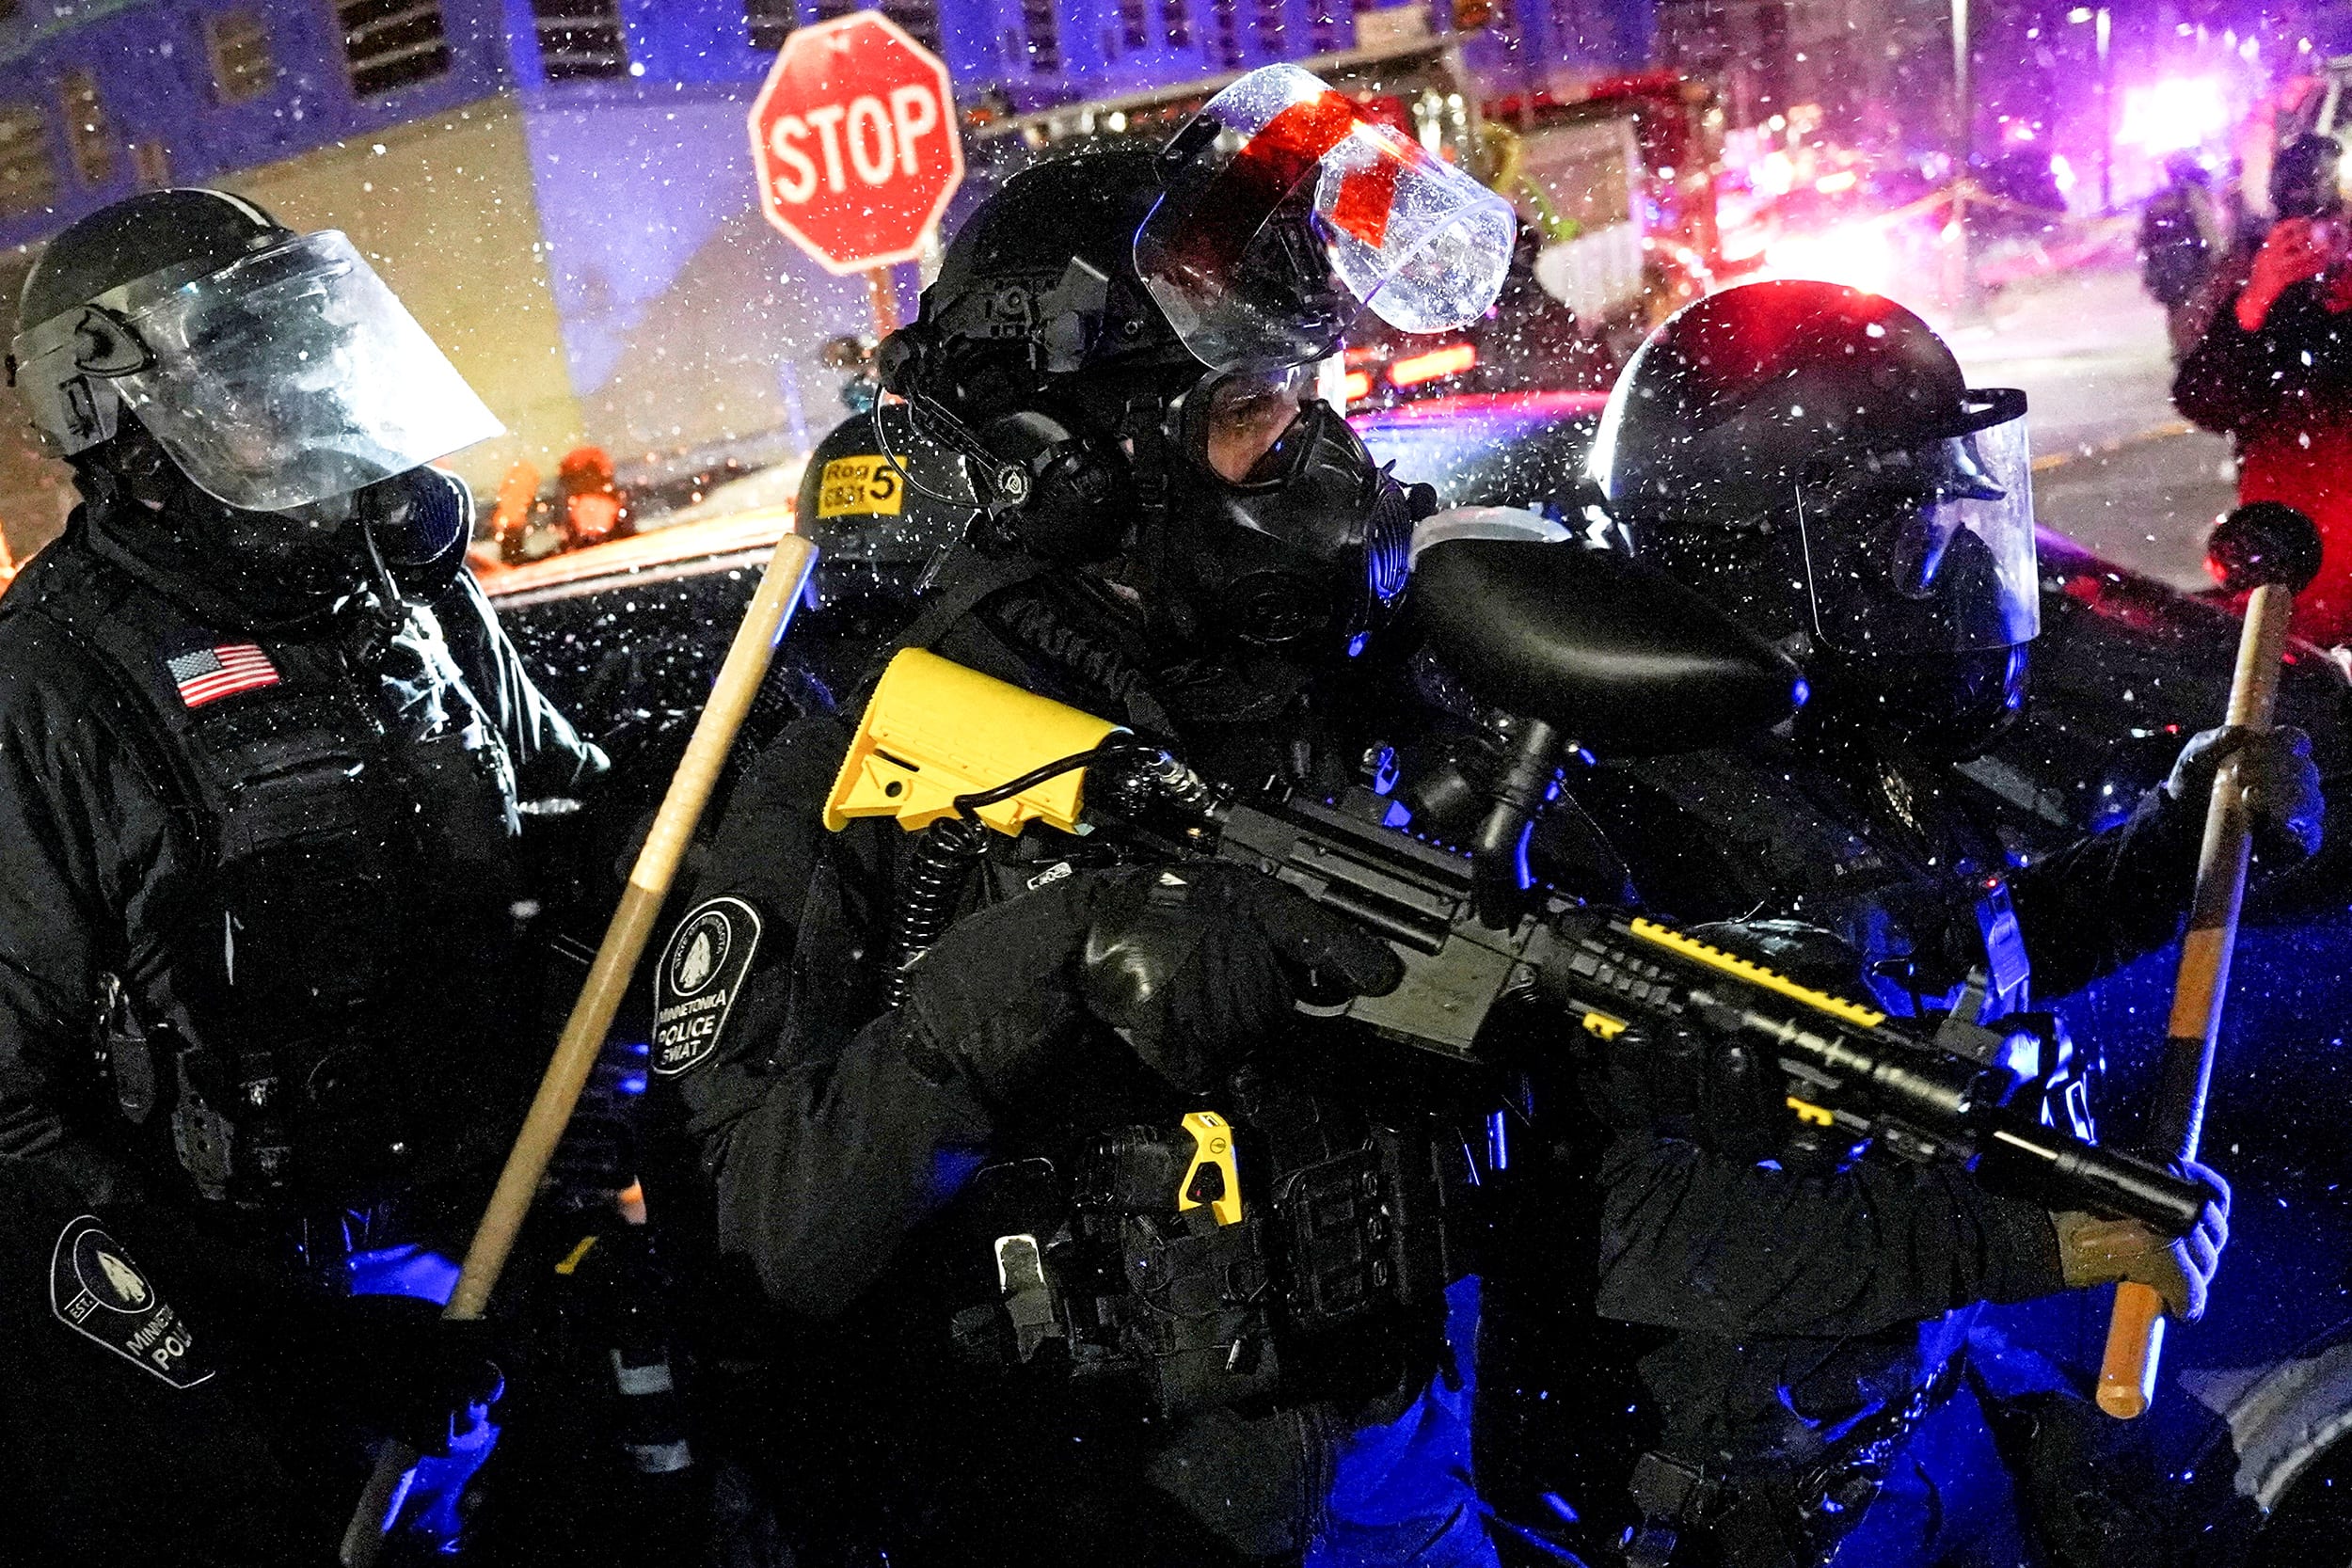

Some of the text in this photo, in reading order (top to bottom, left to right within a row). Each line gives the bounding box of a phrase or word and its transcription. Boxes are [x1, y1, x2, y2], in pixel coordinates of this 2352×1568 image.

[771, 85, 937, 204] STOP
[869, 465, 896, 500] 5
[660, 990, 726, 1023] MINNETONKA
[659, 1014, 716, 1046] POLICE
[660, 1039, 702, 1065] SWAT
[70, 1297, 93, 1320] EST.
